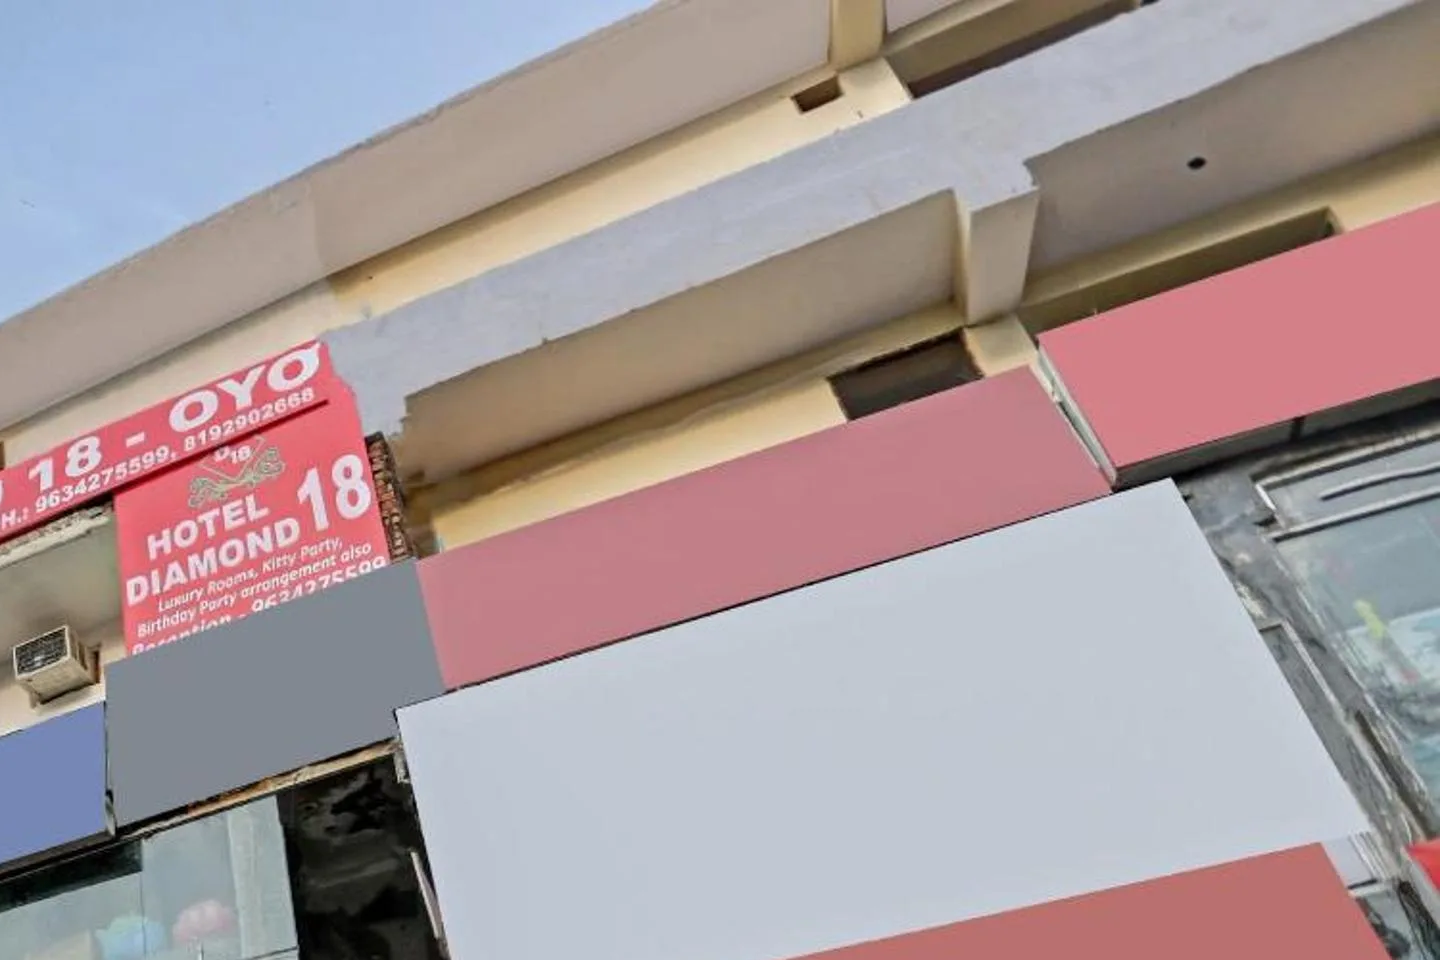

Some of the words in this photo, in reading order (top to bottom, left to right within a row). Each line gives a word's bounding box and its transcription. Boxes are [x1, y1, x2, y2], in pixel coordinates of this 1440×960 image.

[28, 436, 101, 491] 18
[169, 342, 321, 432] OYO
[183, 387, 315, 451] 8192902668
[147, 495, 270, 560] HOTEL
[297, 454, 372, 532] 18
[125, 518, 301, 605] DIAMOND
[137, 605, 197, 638] Birthday
[199, 591, 237, 617] Party
[241, 557, 337, 599] arrangement
[340, 543, 372, 563] also
[158, 585, 206, 613] Luxury
[206, 567, 259, 596] Rooms,
[262, 549, 298, 575] Kitty
[300, 536, 343, 561] Party,
